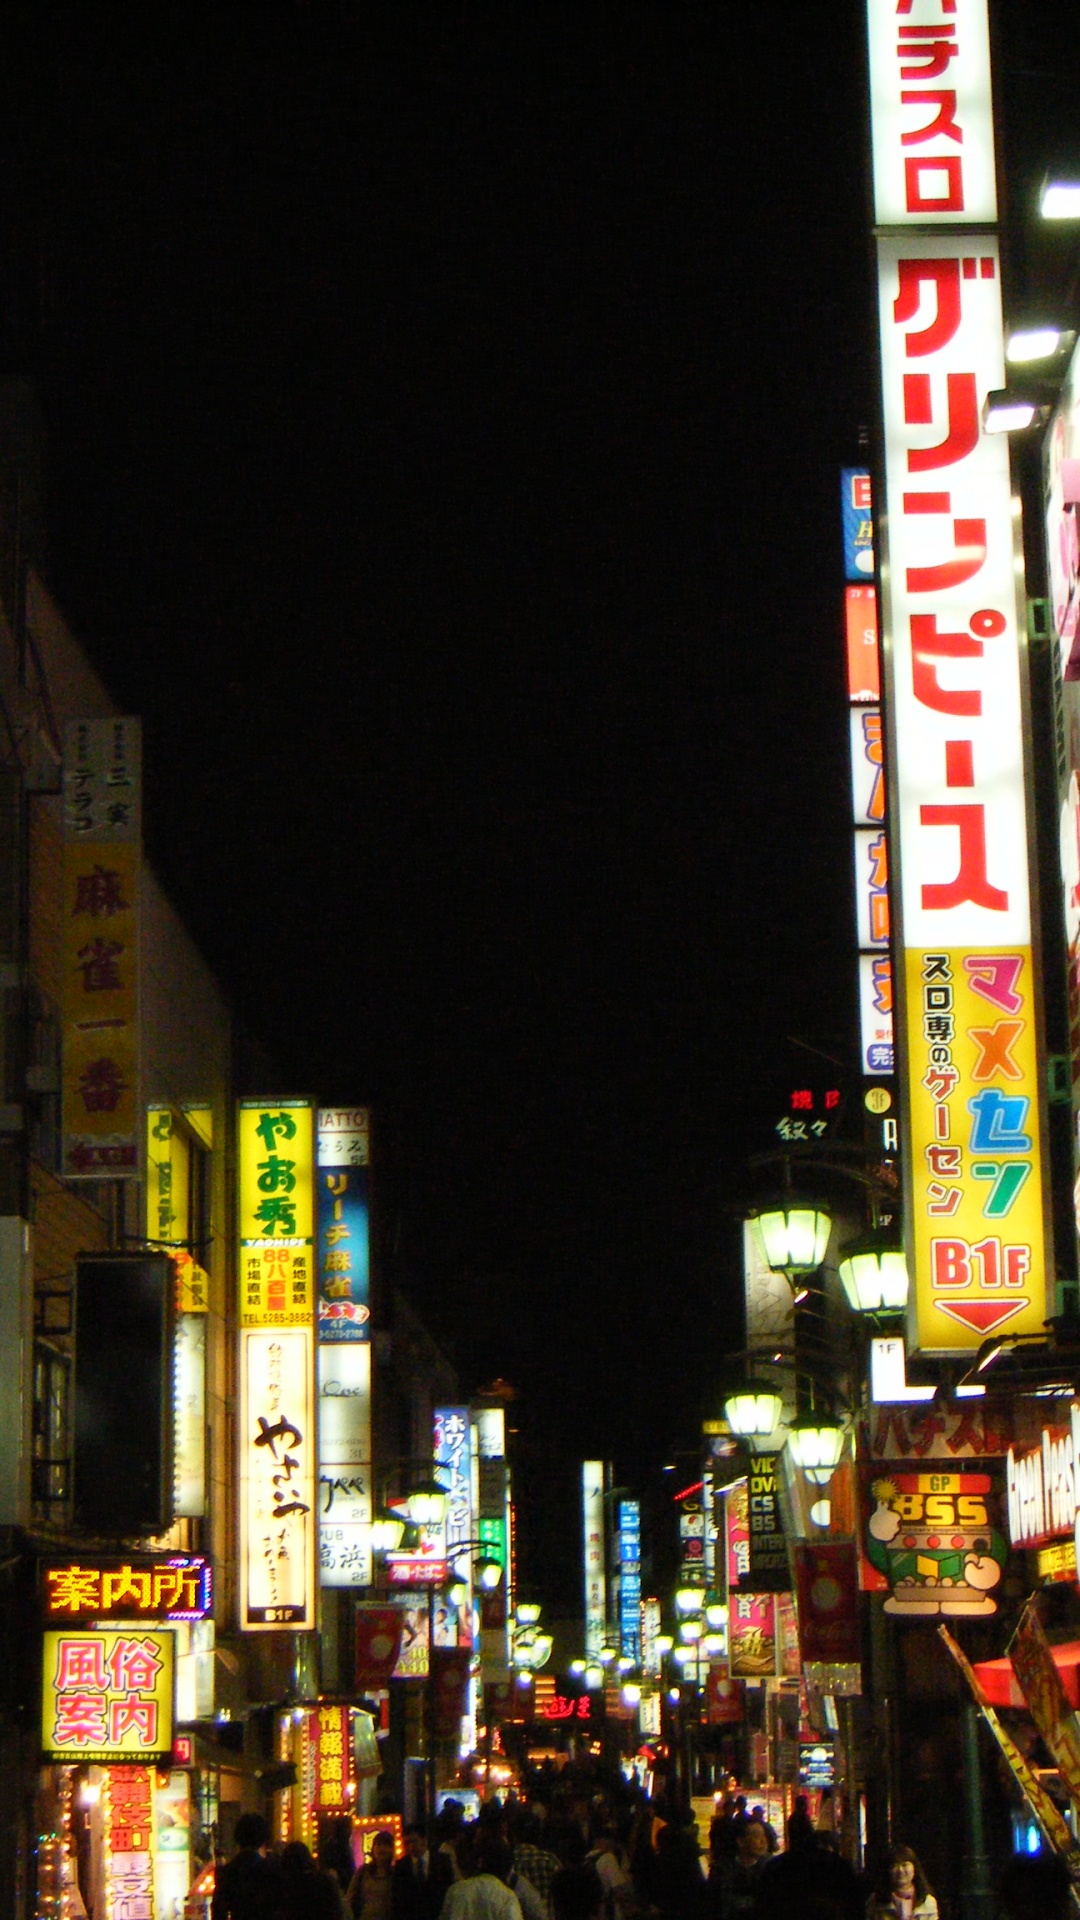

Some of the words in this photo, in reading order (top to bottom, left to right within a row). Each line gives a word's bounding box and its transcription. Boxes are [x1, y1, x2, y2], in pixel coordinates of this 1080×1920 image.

[896, 0, 964, 213] チスロ
[894, 257, 1008, 912] グリンピース
[73, 866, 131, 1114] 麻雀一番
[922, 953, 964, 1218] スロ専のゲーセン
[962, 953, 1033, 1219] マメセン
[252, 1111, 298, 1236] やお秀
[263, 1249, 291, 1263] 88
[323, 1173, 353, 1297] リーチ麻雀
[931, 1236, 1032, 1290] B1F
[751, 1495, 775, 1512] CS
[929, 1475, 950, 1491] GP
[49, 1565, 201, 1611] 案内所
[264, 1609, 294, 1622] B1F
[53, 1637, 163, 1691] 風俗
[52, 1692, 159, 1746] 案内
[318, 1706, 344, 1807] 情報満載
